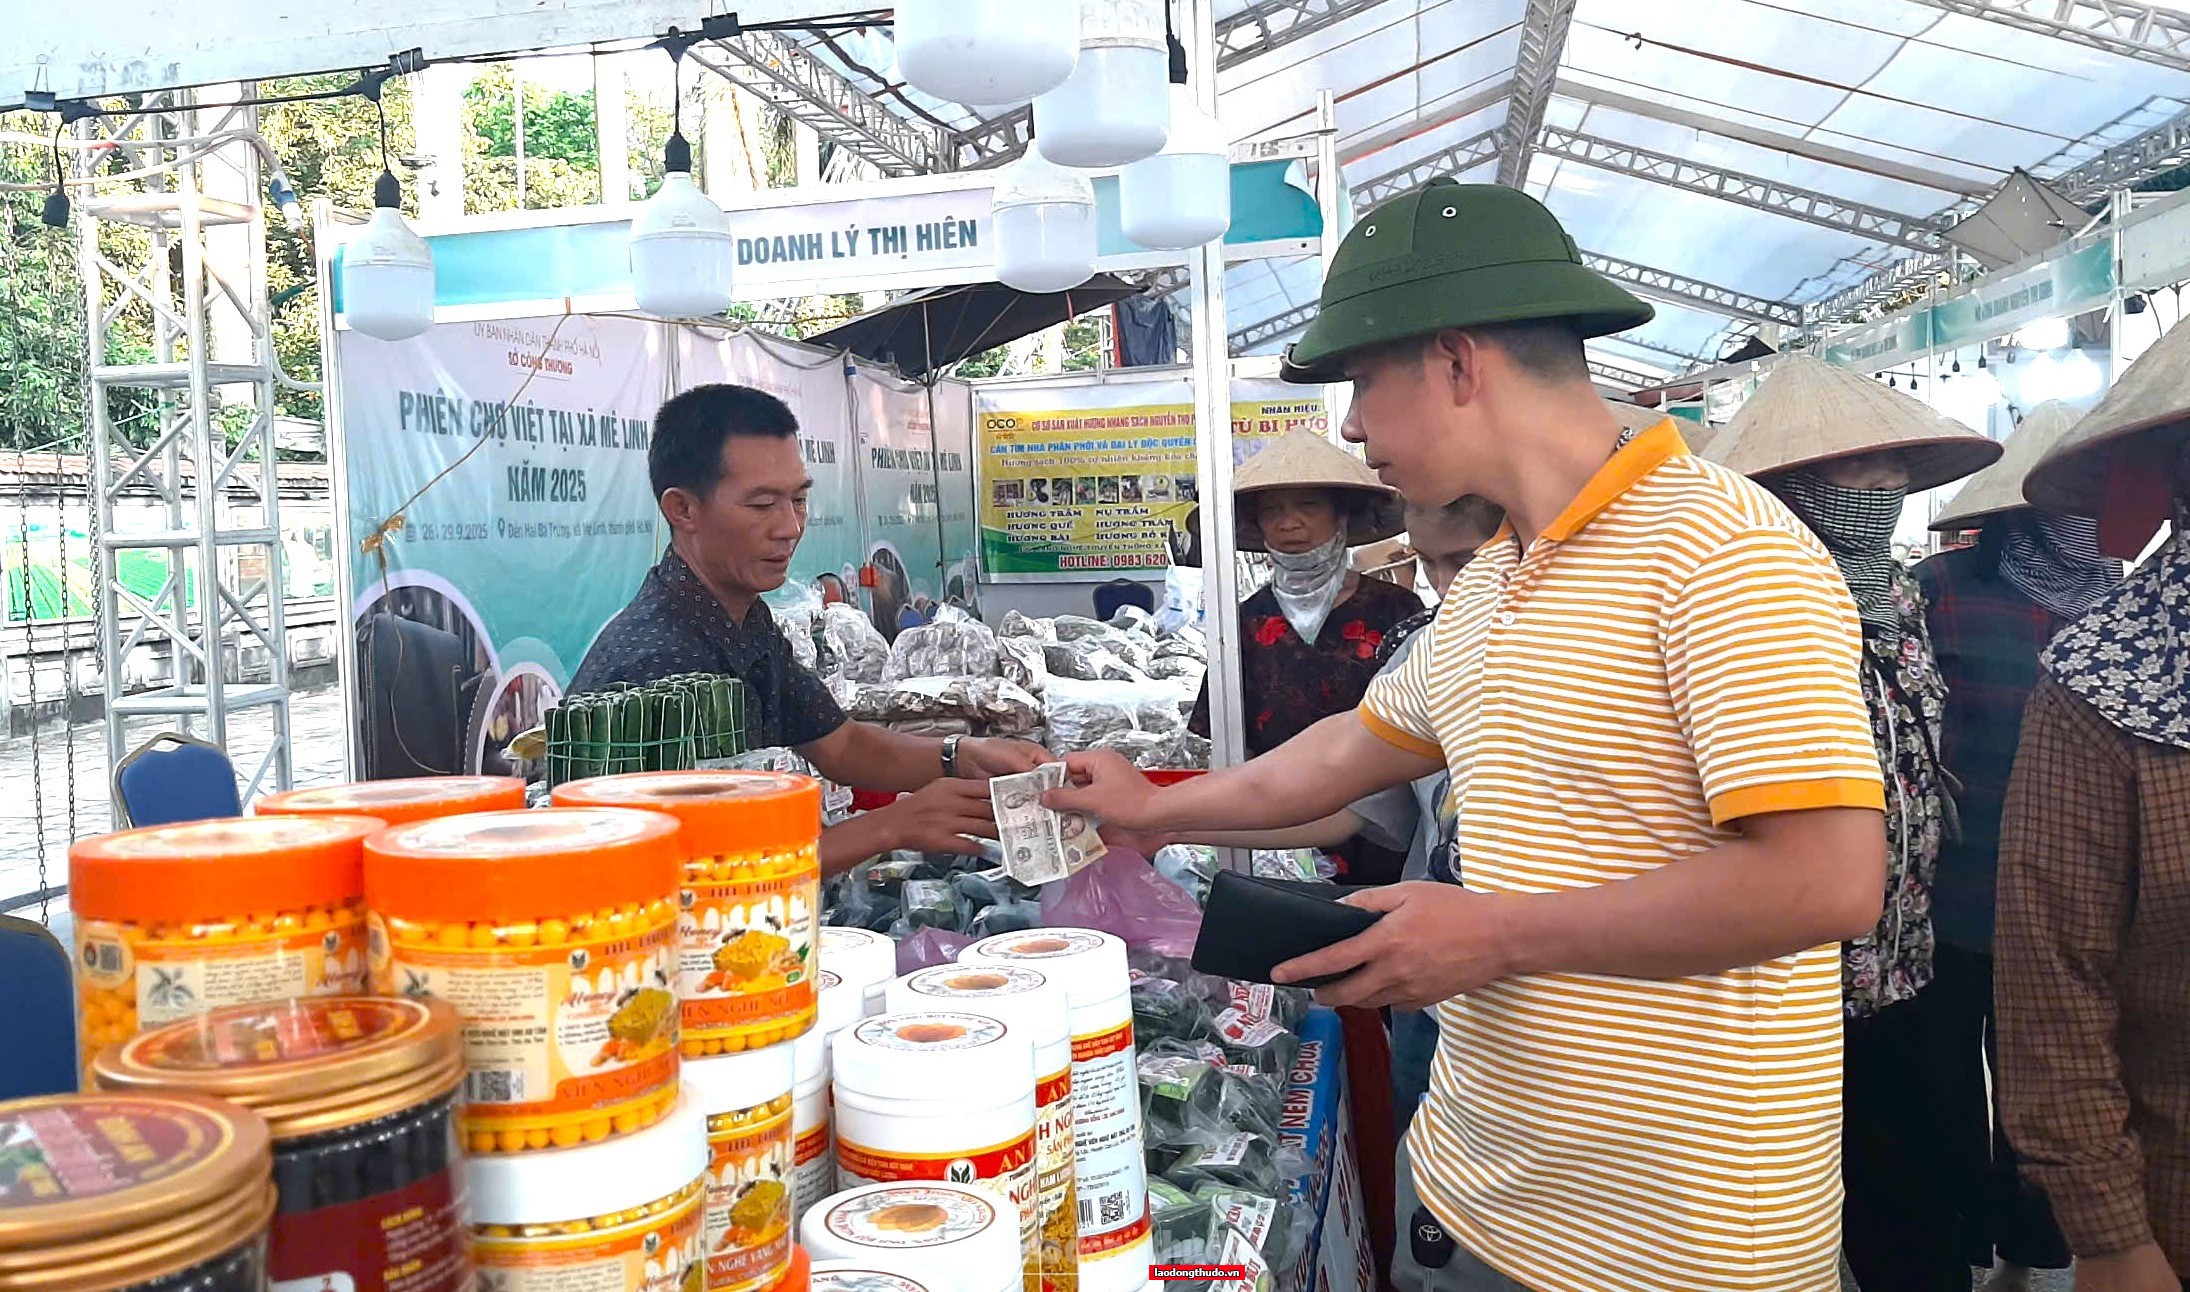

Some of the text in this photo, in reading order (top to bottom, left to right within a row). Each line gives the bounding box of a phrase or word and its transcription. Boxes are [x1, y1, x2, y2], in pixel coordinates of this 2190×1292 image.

[737, 215, 977, 266] DOANH LÝ THỊ HIÊN
[400, 389, 650, 452] PHIÊN CHỢ VIỆT TẠI XÃ MÊ LINH
[987, 418, 1023, 429] OCOP
[1259, 419, 1278, 433] BI
[817, 438, 836, 464] LINH
[507, 459, 588, 502] NĂM 2025
[1160, 531, 1183, 539] KT
[1060, 553, 1166, 567] HOTLINE: 0983 620
[1279, 1090, 1312, 1128] NEM
